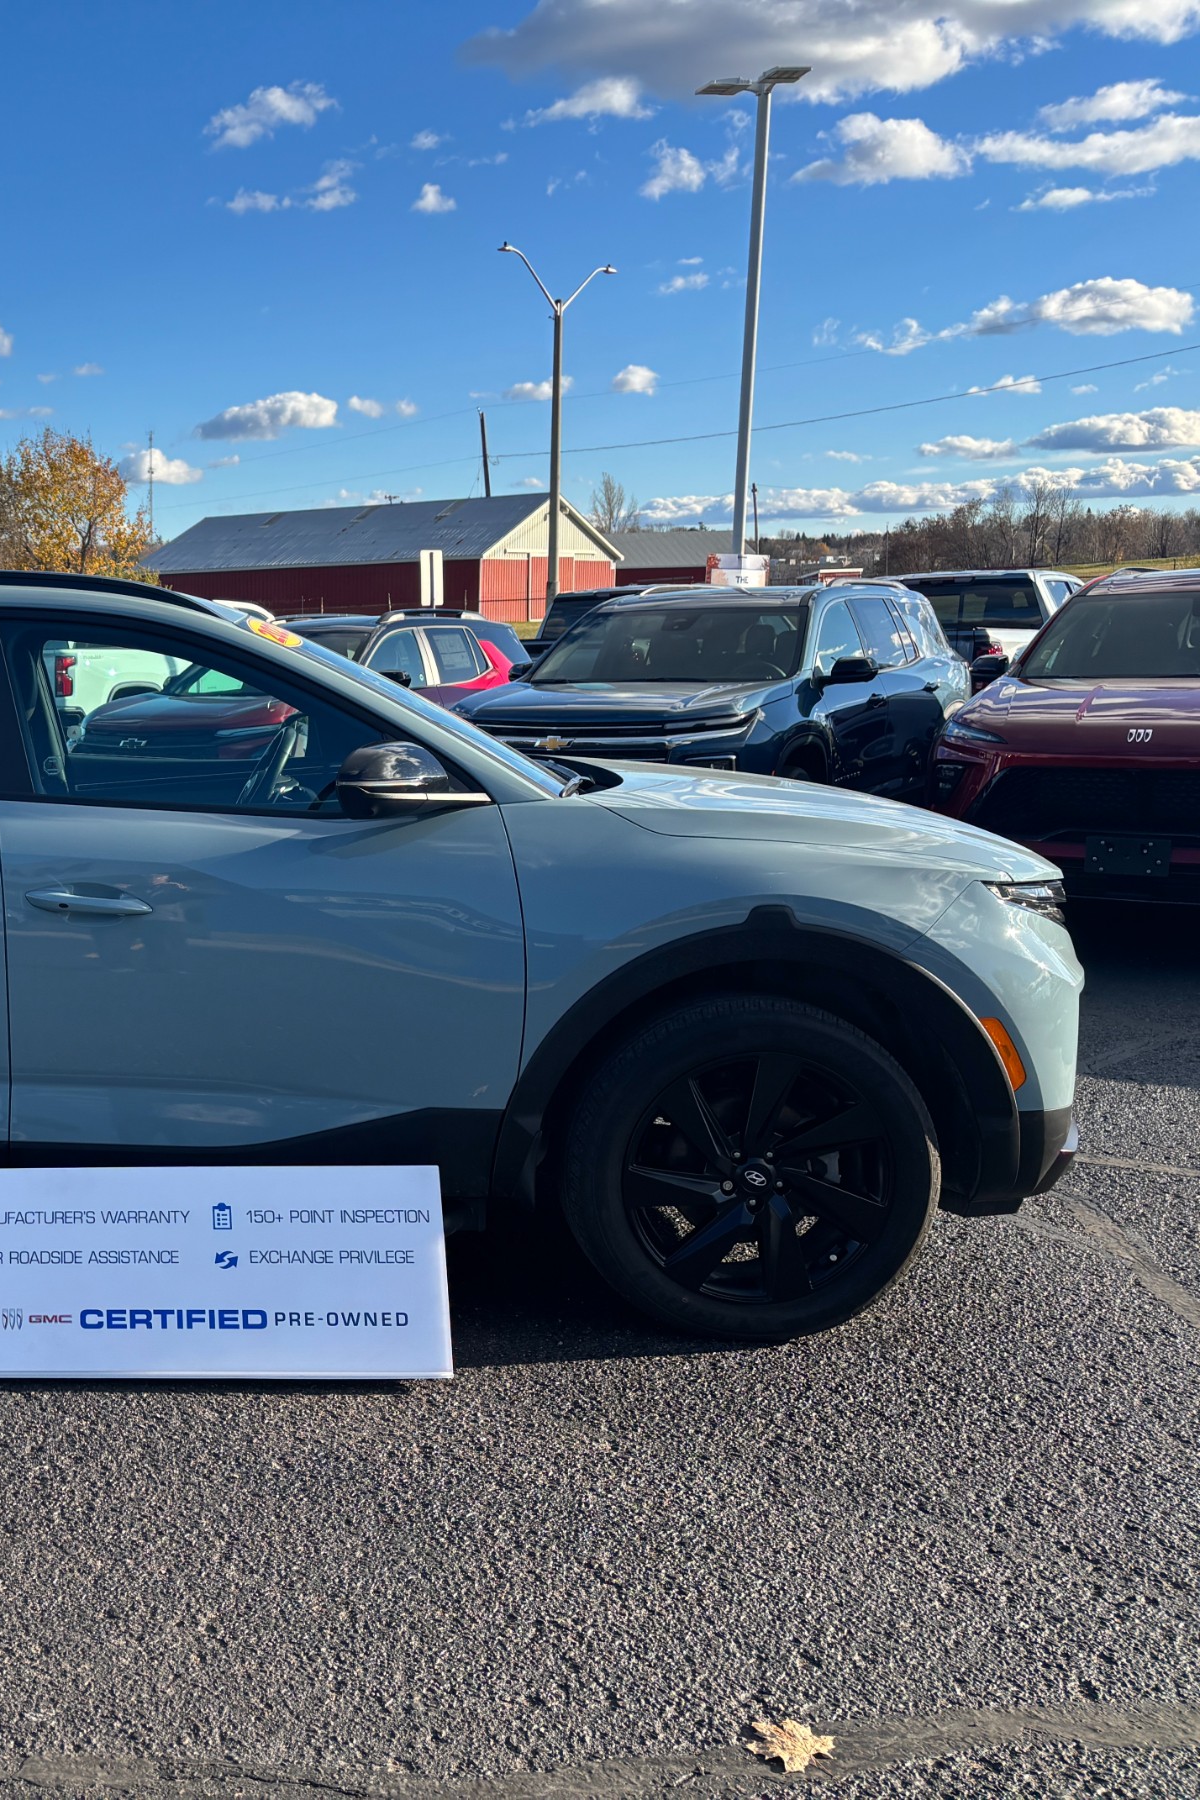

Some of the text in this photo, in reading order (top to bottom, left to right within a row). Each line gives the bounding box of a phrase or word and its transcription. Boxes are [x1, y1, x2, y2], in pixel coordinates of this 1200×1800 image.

[736, 575, 749, 584] THE
[101, 1210, 191, 1225] WARRANTY
[246, 1209, 430, 1224] 150+ POINT INSPECTION
[9, 1250, 83, 1265] ROADSIDE
[88, 1250, 180, 1265] ASSISTANCE
[249, 1250, 415, 1265] EXCHANGE PRIVILEGE
[28, 1309, 410, 1330] GMC CERTIFIED PRE-OWNED
